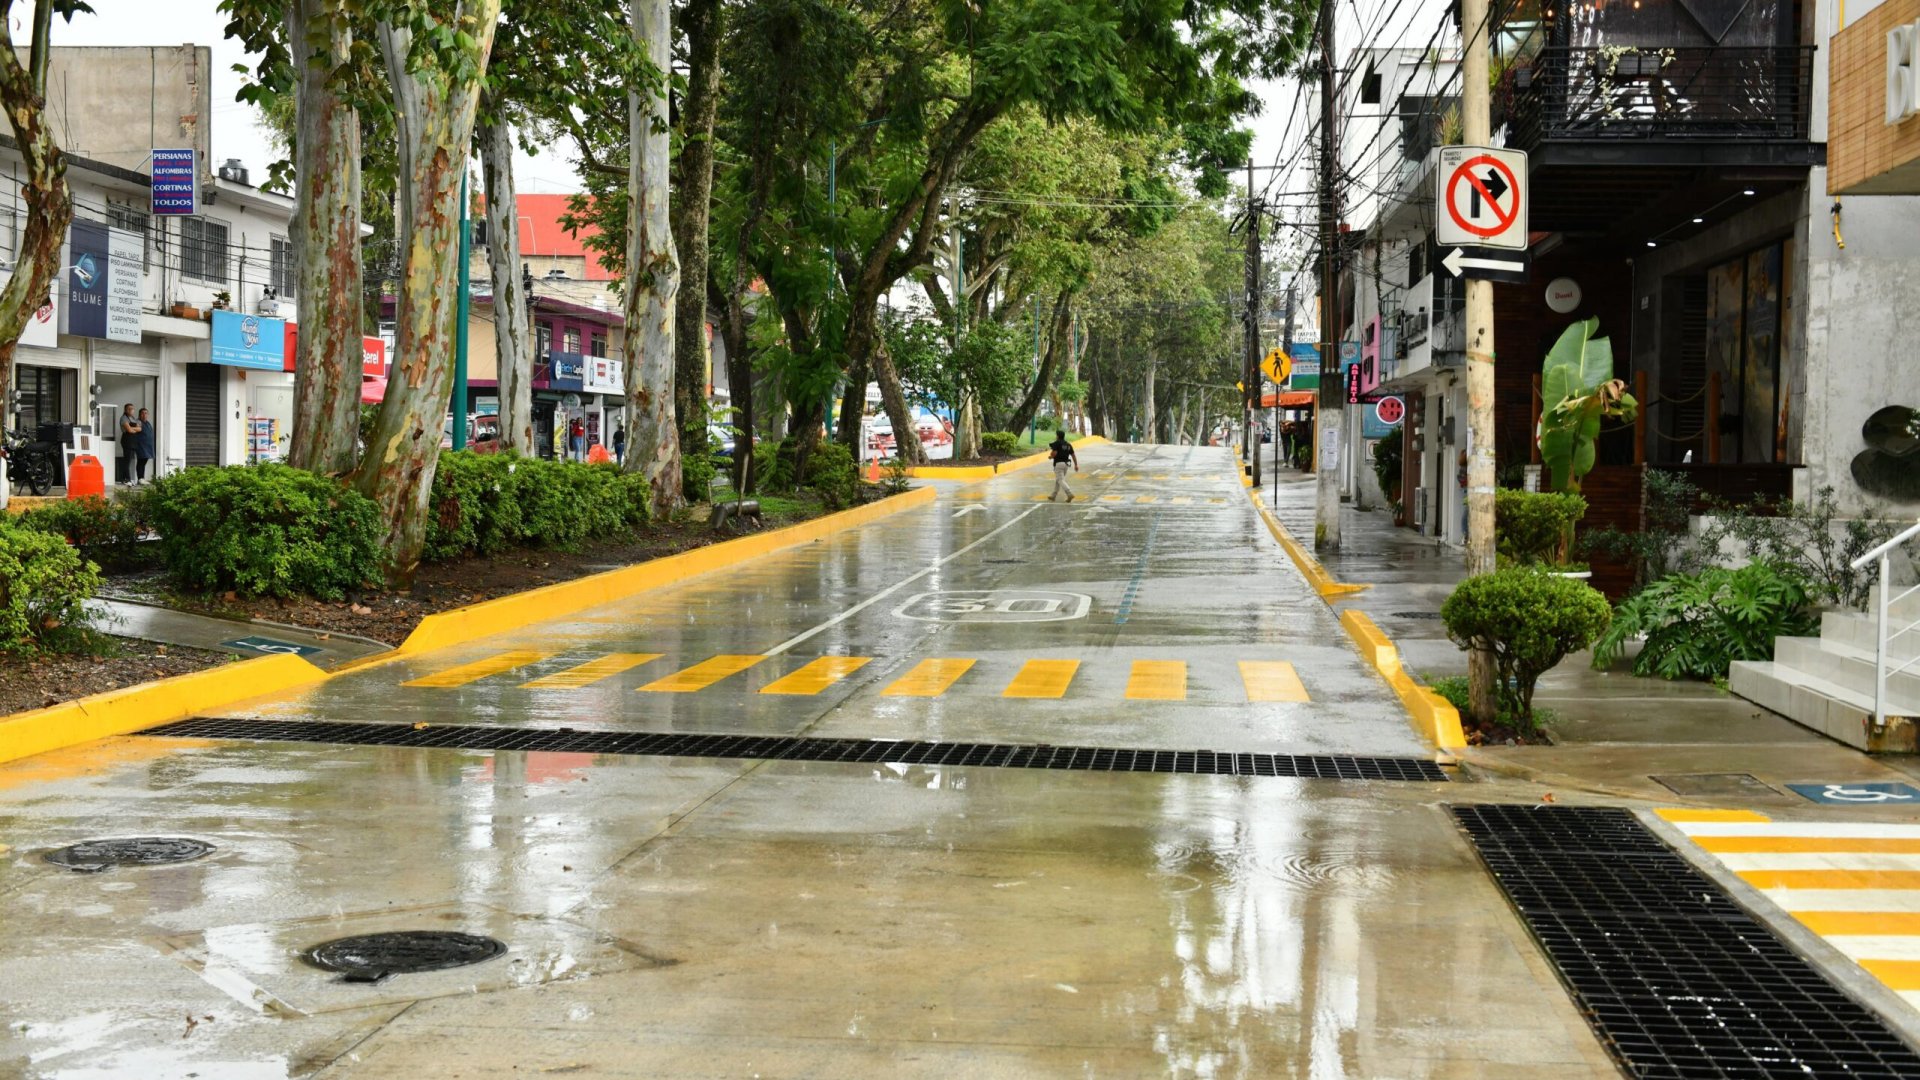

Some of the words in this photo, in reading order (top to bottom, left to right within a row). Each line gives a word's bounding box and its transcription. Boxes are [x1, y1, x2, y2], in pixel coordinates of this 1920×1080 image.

[115, 268, 138, 278] PERSIANAS
[116, 278, 136, 288] CORTINAS
[114, 288, 138, 297] ALFOMBRAS
[72, 290, 102, 306] BLUME
[1350, 364, 1358, 402] ABIERTO
